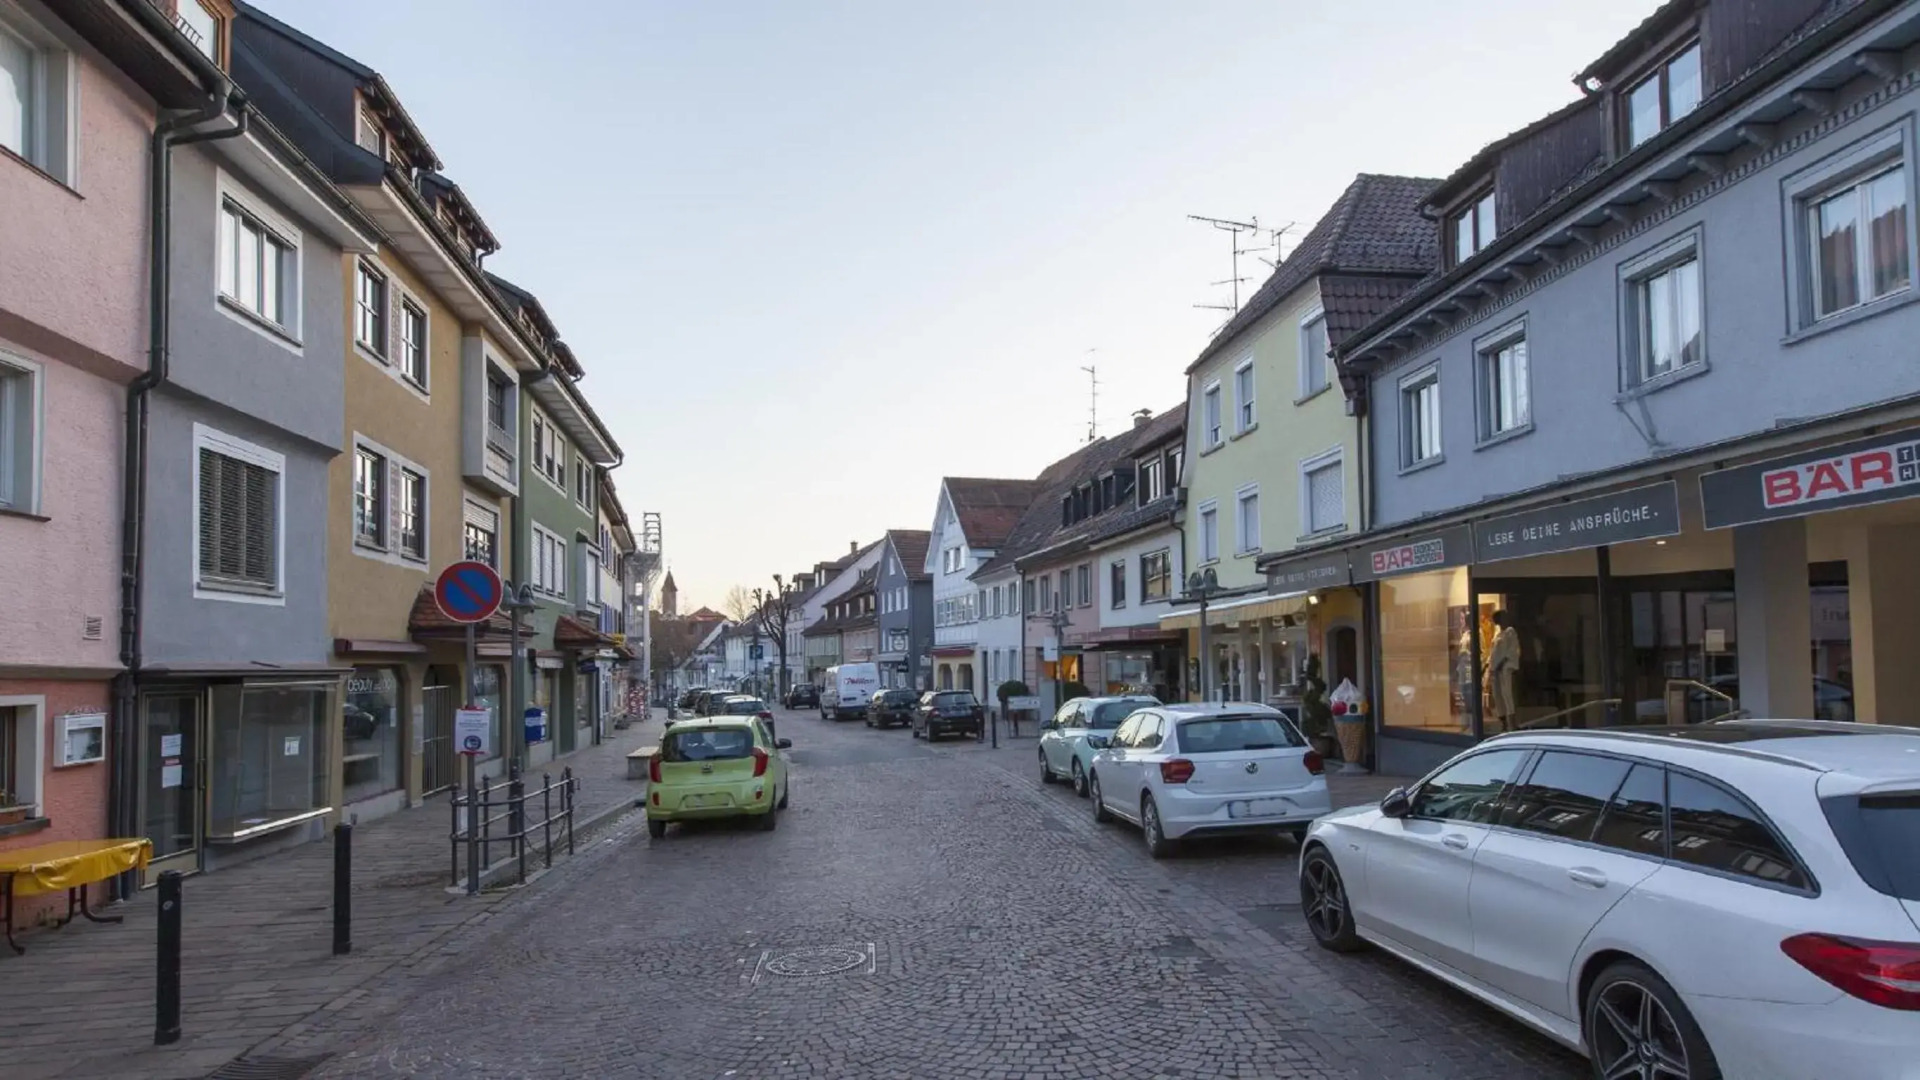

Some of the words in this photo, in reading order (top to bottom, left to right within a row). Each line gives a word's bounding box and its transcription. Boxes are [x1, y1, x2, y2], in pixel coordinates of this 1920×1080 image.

[1764, 451, 1895, 506] BÄR
[1488, 531, 1515, 546] LEBE
[1522, 523, 1561, 540] DEINE
[1569, 505, 1659, 532] ANSPRÜCHE.
[1373, 547, 1414, 572] BÄR
